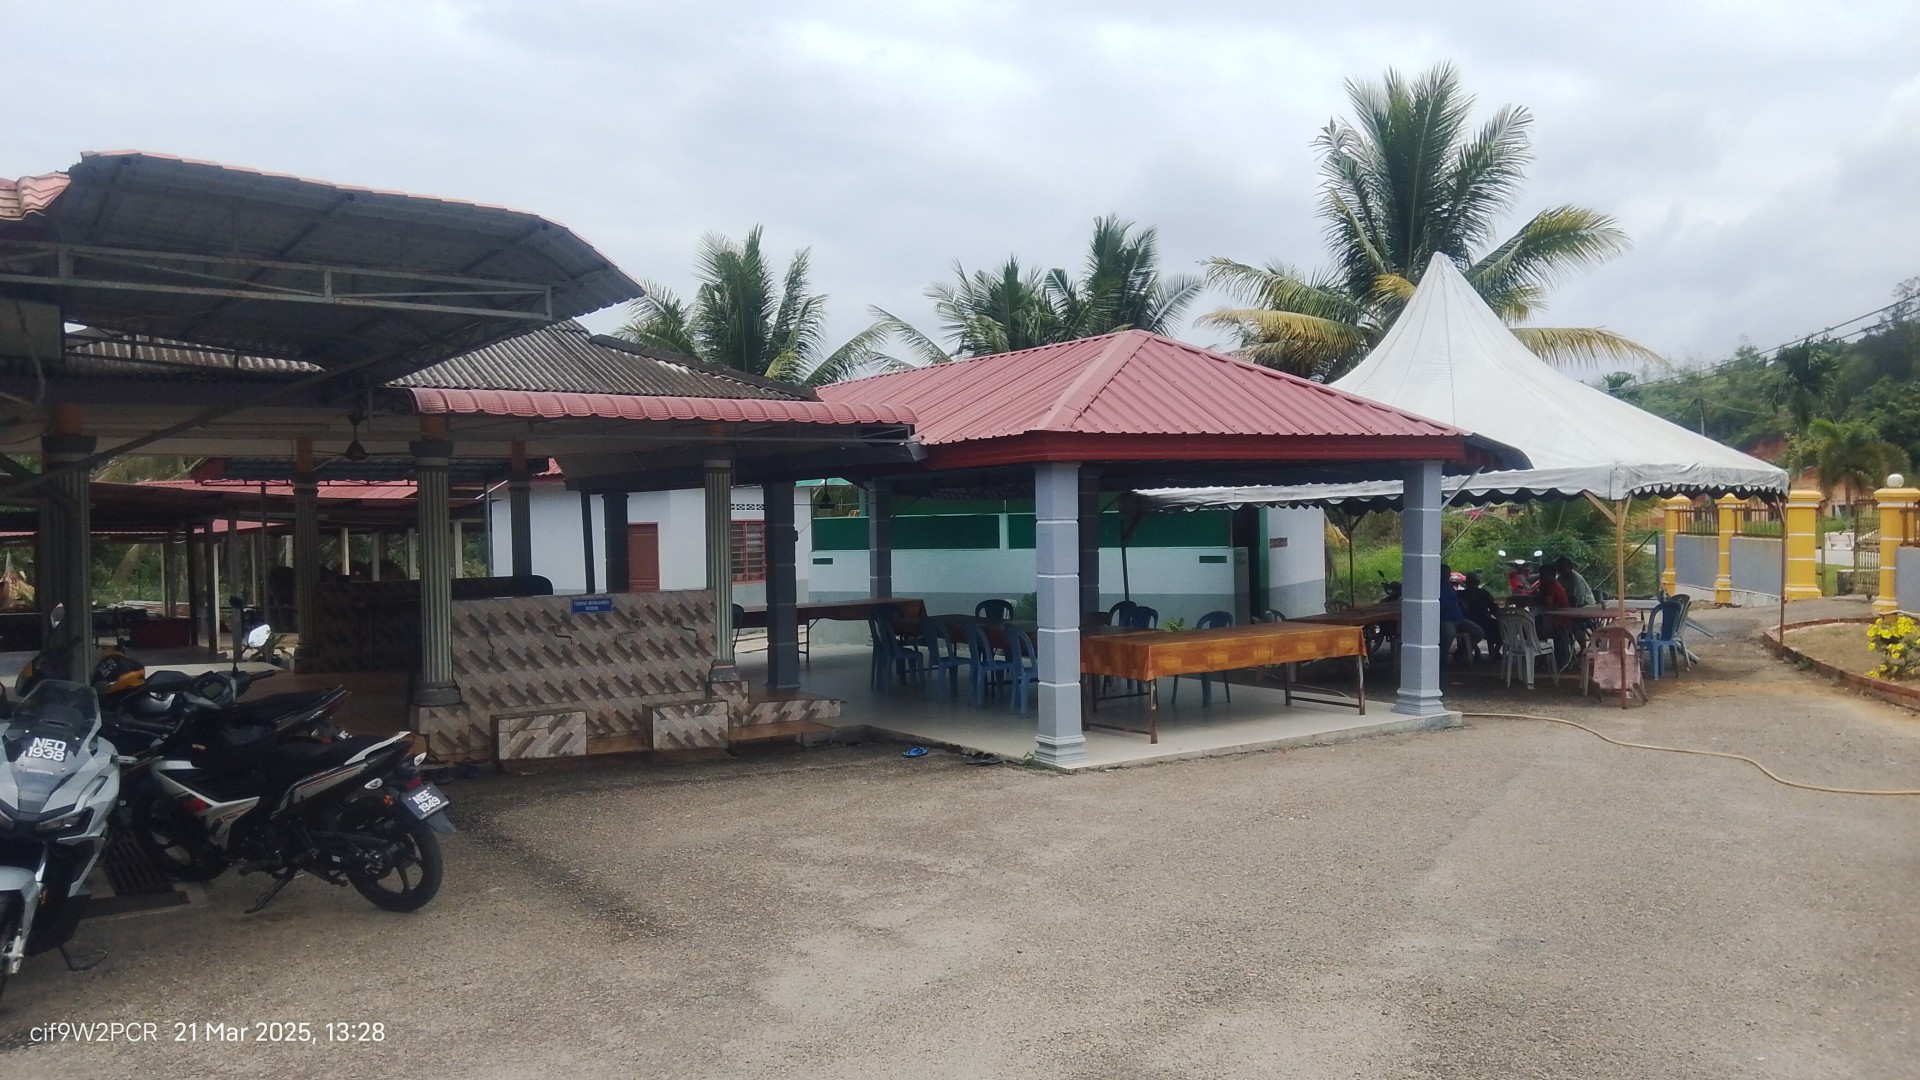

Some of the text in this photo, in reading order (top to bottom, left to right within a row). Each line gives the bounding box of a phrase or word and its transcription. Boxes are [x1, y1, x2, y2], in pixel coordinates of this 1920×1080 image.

[32, 737, 67, 751] NED
[28, 746, 65, 762] 1938
[27, 768, 55, 776] HONDA
[412, 789, 433, 805] NEE
[419, 796, 441, 813] 1949
